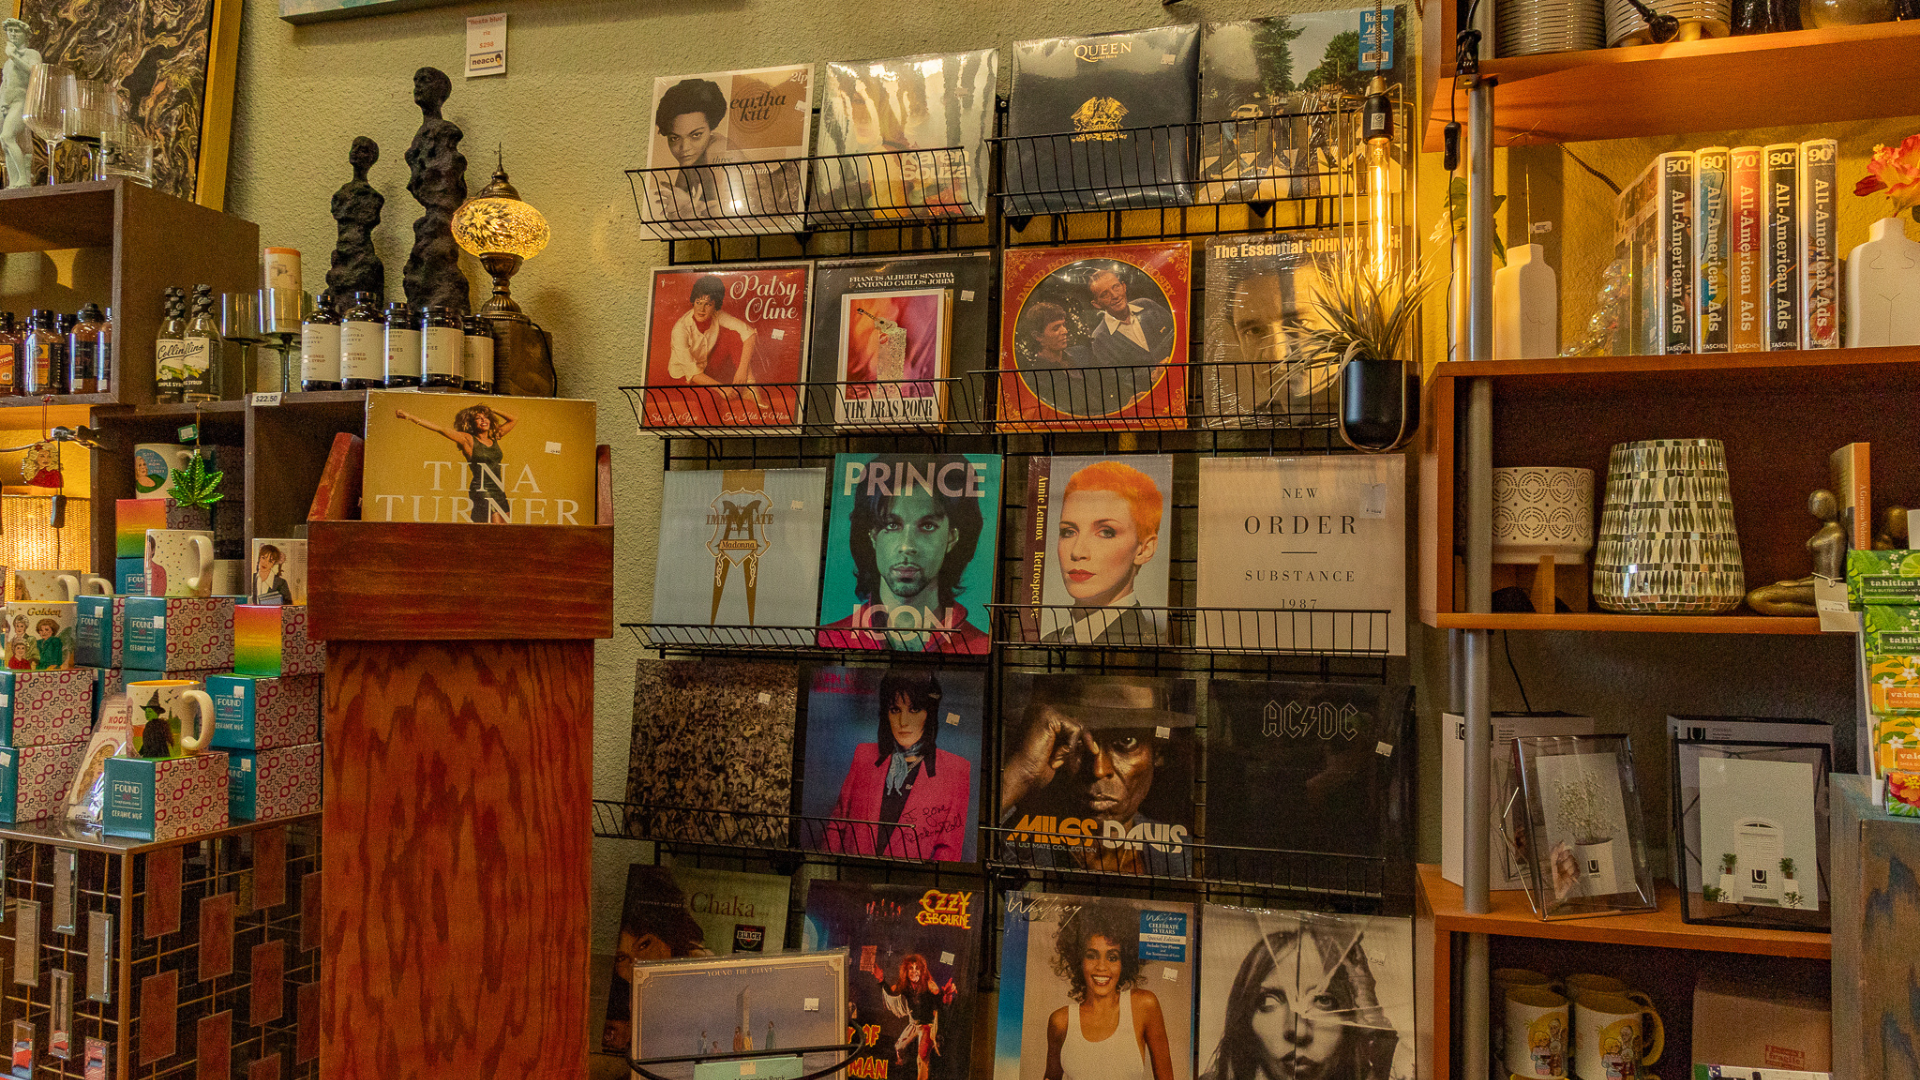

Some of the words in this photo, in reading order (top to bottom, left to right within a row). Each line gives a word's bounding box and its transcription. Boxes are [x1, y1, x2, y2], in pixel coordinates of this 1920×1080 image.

[1365, 13, 1389, 22] BEAES
[472, 57, 494, 65] neaco
[1073, 42, 1133, 62] QUEEN
[730, 91, 786, 110] eartha
[740, 106, 770, 121] kitt
[901, 150, 970, 167] Karen
[901, 163, 972, 181] Souza
[1672, 190, 1685, 298] All-American
[1708, 186, 1721, 295] All-American
[1740, 185, 1754, 295] All-American
[1776, 183, 1791, 293] All-American
[1815, 179, 1830, 290] All-American
[1214, 245, 1238, 259] The
[1241, 240, 1304, 257] Essential
[849, 275, 884, 283] FRANCIS
[884, 273, 919, 281] ALBERT
[855, 280, 893, 288] ANTONIO
[894, 279, 927, 287] CARLOS
[1016, 269, 1046, 302] DAVID
[729, 274, 799, 306] Patsy
[745, 297, 798, 323] Cline
[1672, 303, 1685, 334] Ads
[1708, 301, 1722, 332] Ads
[1741, 300, 1755, 331] Ads
[1777, 298, 1791, 330] Ads
[1816, 296, 1831, 327] Ads
[157, 345, 184, 362] Collin
[844, 401, 867, 418] THE
[902, 399, 933, 417] POUR
[423, 461, 543, 494] TINA
[844, 462, 987, 497] PRINCE
[1037, 475, 1049, 503] Annie
[1282, 488, 1318, 498] NEW
[376, 495, 580, 525] TURNER
[1035, 506, 1047, 540] Lennox
[1244, 515, 1357, 535] ORDER
[722, 541, 755, 549] Madonna
[127, 576, 146, 584] FOUN
[1245, 570, 1356, 582] SUBSTANCE
[1870, 579, 1915, 587] tahitian
[27, 608, 62, 618] Golden
[1281, 599, 1318, 609] 1987
[131, 620, 153, 629] FOUND
[851, 604, 953, 645] ICON
[217, 698, 242, 707] FOUND
[1891, 690, 1920, 698] valen
[114, 784, 140, 795] FOUND
[111, 809, 131, 819] CERAMIC
[1006, 814, 1098, 847] MILES
[1102, 819, 1188, 853] DAVIS
[690, 891, 755, 918] Chaka
[919, 889, 973, 915] OZZY
[915, 910, 971, 930] OSBOURNE
[1007, 896, 1083, 933] Whitney
[1146, 913, 1183, 925] Whitney
[737, 930, 761, 941] BLACK
[707, 968, 733, 977] YOUNG
[751, 966, 774, 975] GIANT
[848, 1055, 889, 1080] MAN
